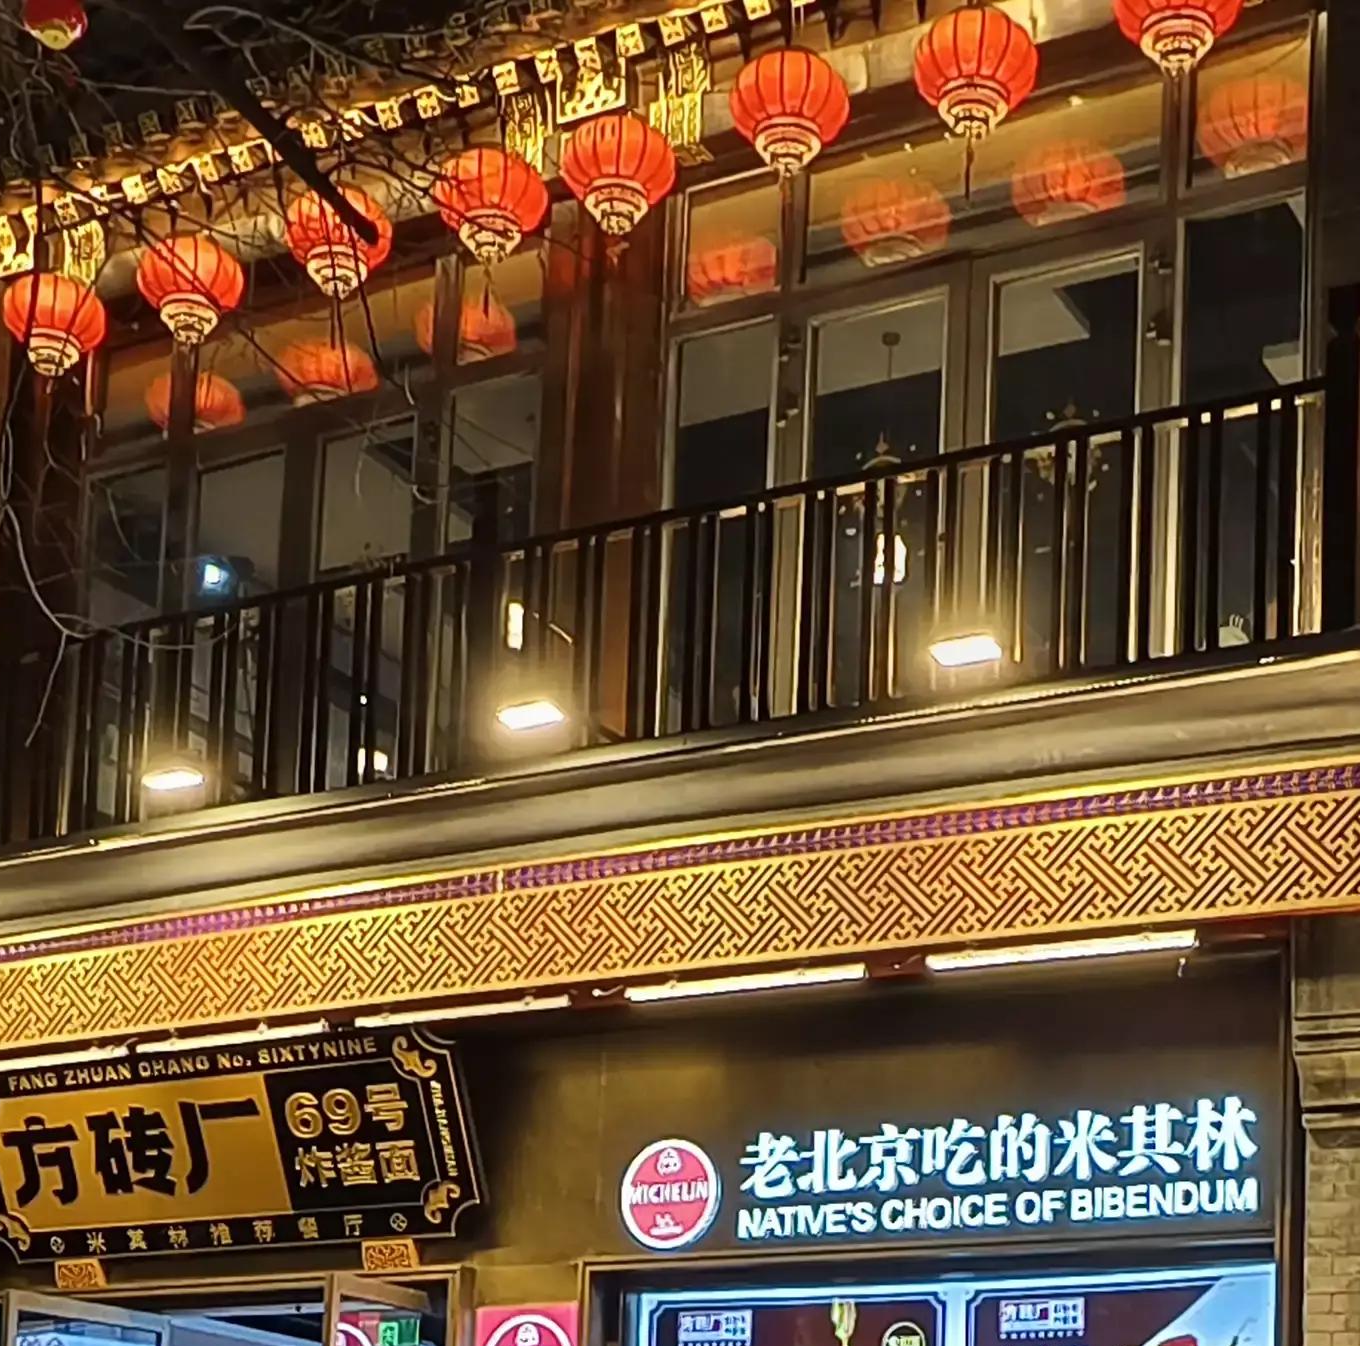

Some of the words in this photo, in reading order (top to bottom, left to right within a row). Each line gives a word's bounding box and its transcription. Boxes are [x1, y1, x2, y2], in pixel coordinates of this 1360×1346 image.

[8, 1072, 57, 1092] FANG
[64, 1063, 131, 1086] ZHUAN
[138, 1056, 210, 1078] CHANG
[258, 1037, 377, 1065] SIXTYNINE
[284, 1082, 409, 1139] 69号
[1, 1098, 262, 1208] 方砖厂
[295, 1140, 421, 1188] 炸酱面
[740, 1096, 1258, 1200] 老北京吃的米其林
[629, 1180, 710, 1205] MICHELIN
[737, 1200, 876, 1240] NATIVE'S
[882, 1192, 1009, 1232] CHOICE
[1015, 1188, 1066, 1224] OF
[1071, 1177, 1258, 1221] BIBENDUM
[86, 1213, 363, 1254] 米其林推荐餐厅
